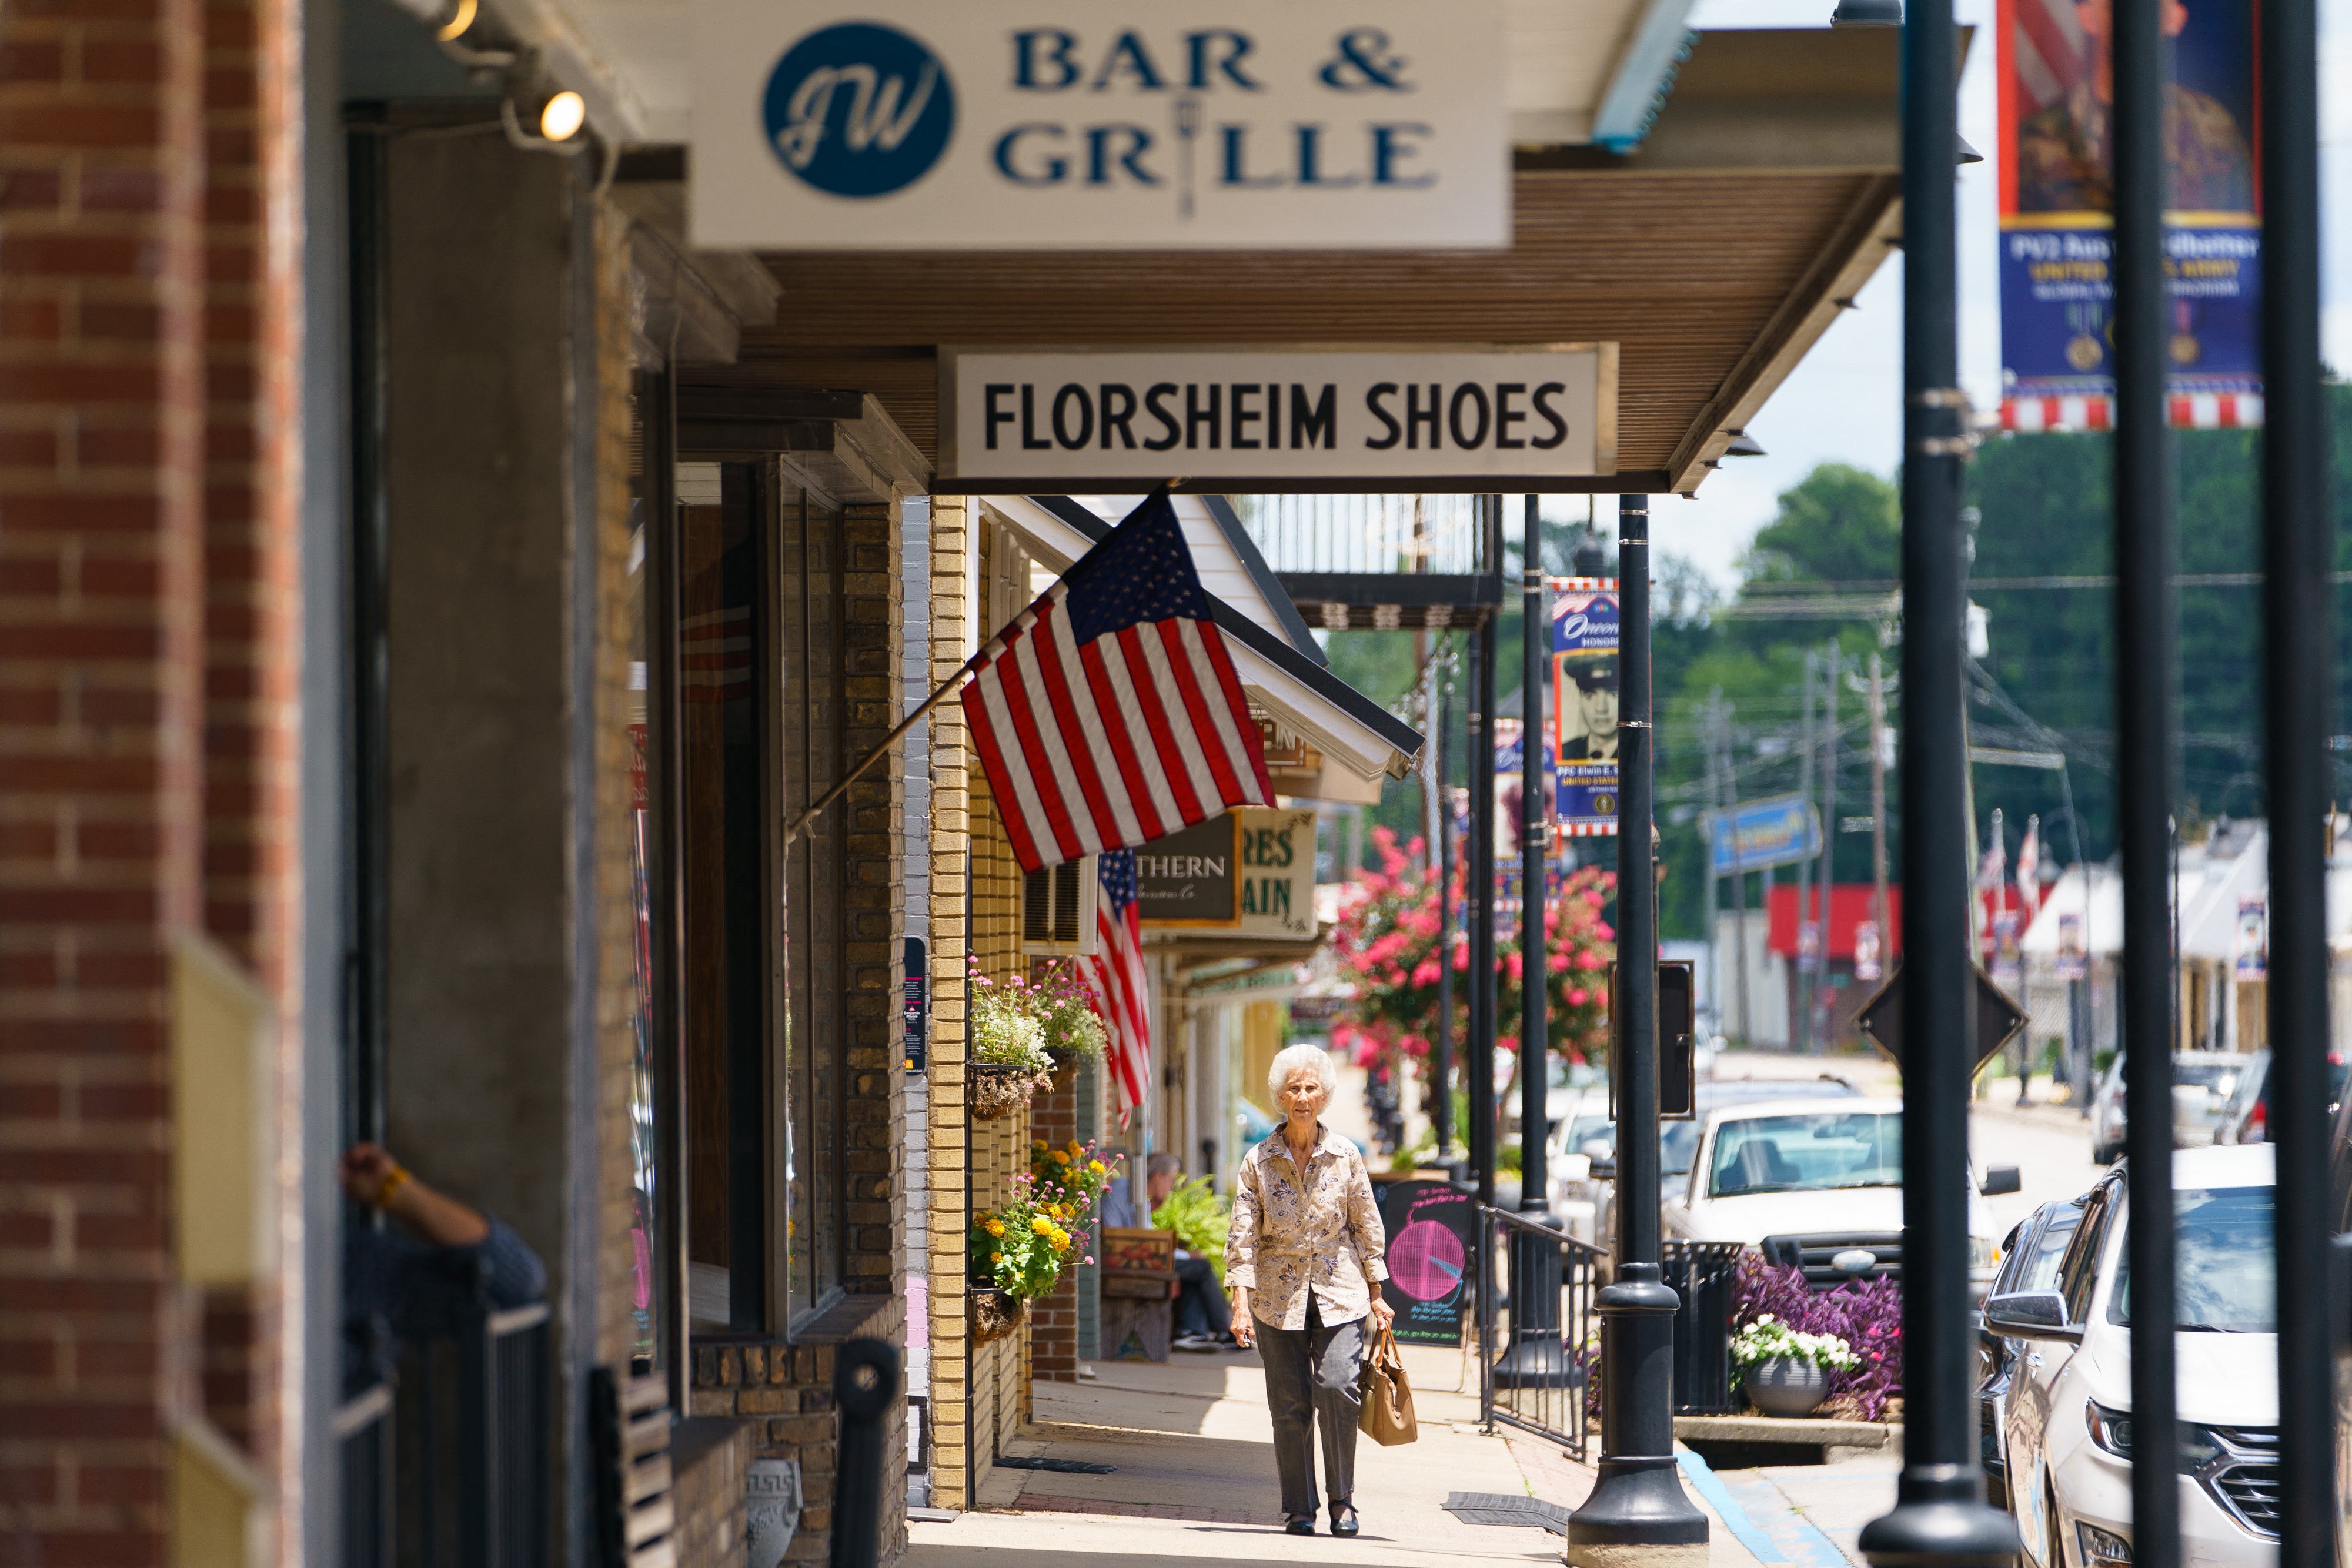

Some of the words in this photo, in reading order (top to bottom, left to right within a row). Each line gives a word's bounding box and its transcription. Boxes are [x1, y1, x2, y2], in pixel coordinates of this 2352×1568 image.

[1010, 26, 1264, 93] BAR
[1316, 25, 1416, 93] &
[993, 119, 1438, 194] GRILLE
[984, 382, 1337, 450] FLORSHEIM
[1365, 382, 1568, 450] SHOES
[1556, 766, 1576, 777] PFC
[1561, 776, 1592, 787] UNITED
[1135, 856, 1225, 878] THERN
